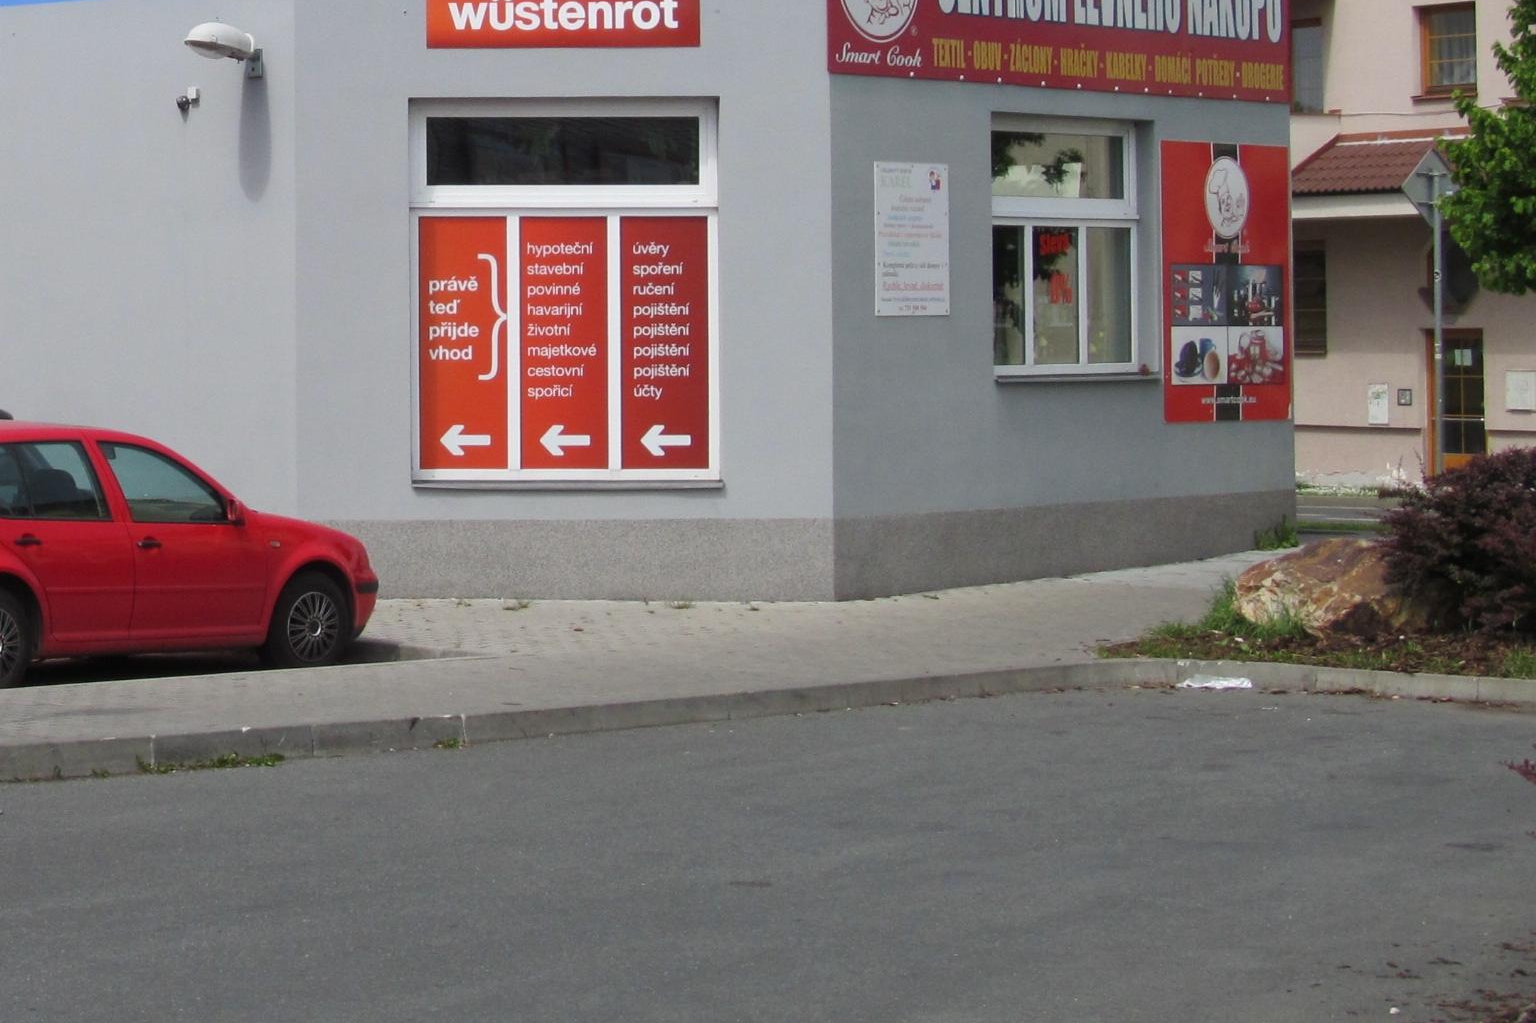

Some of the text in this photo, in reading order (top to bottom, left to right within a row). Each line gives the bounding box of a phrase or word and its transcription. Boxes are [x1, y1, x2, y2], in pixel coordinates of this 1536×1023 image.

[835, 41, 922, 68] Smart Cook
[932, 37, 966, 69] TEXTIL
[973, 40, 1002, 71] OBUV
[1010, 38, 1053, 74] ZÁCLONY
[1060, 43, 1099, 78] HRAČKY
[1105, 51, 1147, 82] KABELKY
[527, 241, 670, 257] hypoteční úvěry
[527, 262, 683, 277] stavební spoření
[428, 276, 479, 295] právě
[527, 282, 675, 298] povinné ručení
[428, 299, 461, 315] teď
[527, 302, 690, 318] havarijní pojištění
[428, 322, 480, 341] přijde
[527, 323, 690, 338] životní pojištění
[428, 345, 473, 361] vhod
[527, 343, 690, 359] majetkové pojištění
[528, 364, 690, 379] cestovní pojištění
[528, 384, 663, 400] spořicí účty
